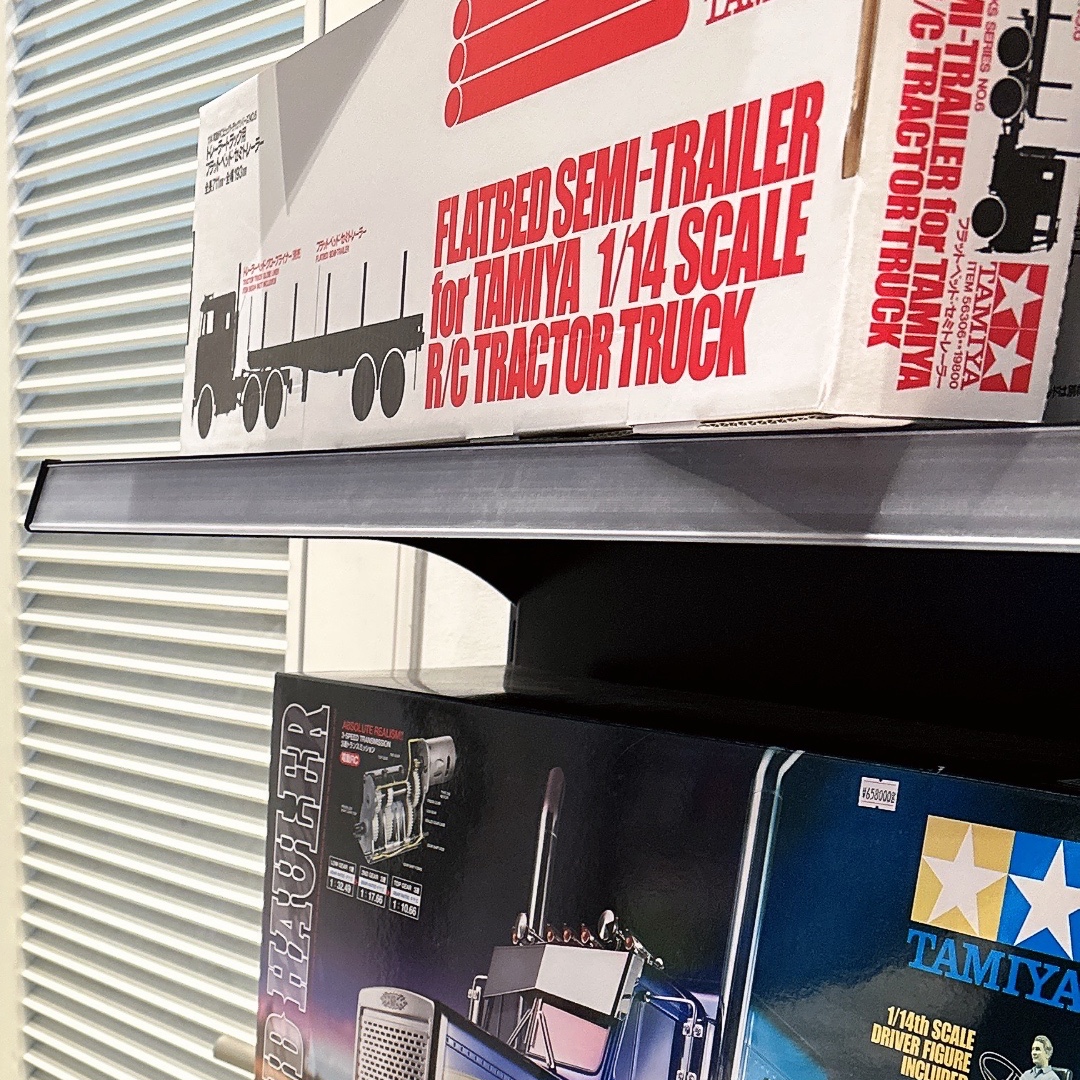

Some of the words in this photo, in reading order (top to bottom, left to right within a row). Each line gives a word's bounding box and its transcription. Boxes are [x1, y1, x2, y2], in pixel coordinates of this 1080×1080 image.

[974, 78, 989, 112] NO.6
[980, 21, 996, 73] SERIES
[434, 167, 551, 267] FLATBED
[553, 81, 824, 237] SEMI-TRAILER
[885, 47, 942, 221] TRACTOR
[430, 271, 470, 338] for
[474, 237, 581, 331] TAMIYA
[598, 215, 669, 308] 1/14
[674, 180, 814, 295] SCALE
[918, 197, 957, 253] for
[963, 261, 977, 293] ITEM
[425, 337, 470, 409] R/C
[474, 312, 613, 404] TRACTOR
[618, 287, 756, 388] TRUCK
[867, 226, 917, 348] TRUCK
[896, 259, 948, 391] TAMIYA
[960, 261, 998, 391] TAMIYA
[267, 703, 331, 1014] HAULER
[887, 1006, 930, 1037] 1/14th
[931, 1019, 976, 1051] SCALE
[906, 928, 1080, 1014] TAMIYA
[871, 1023, 921, 1057] DRIVER
[922, 1039, 972, 1073] FIGURE
